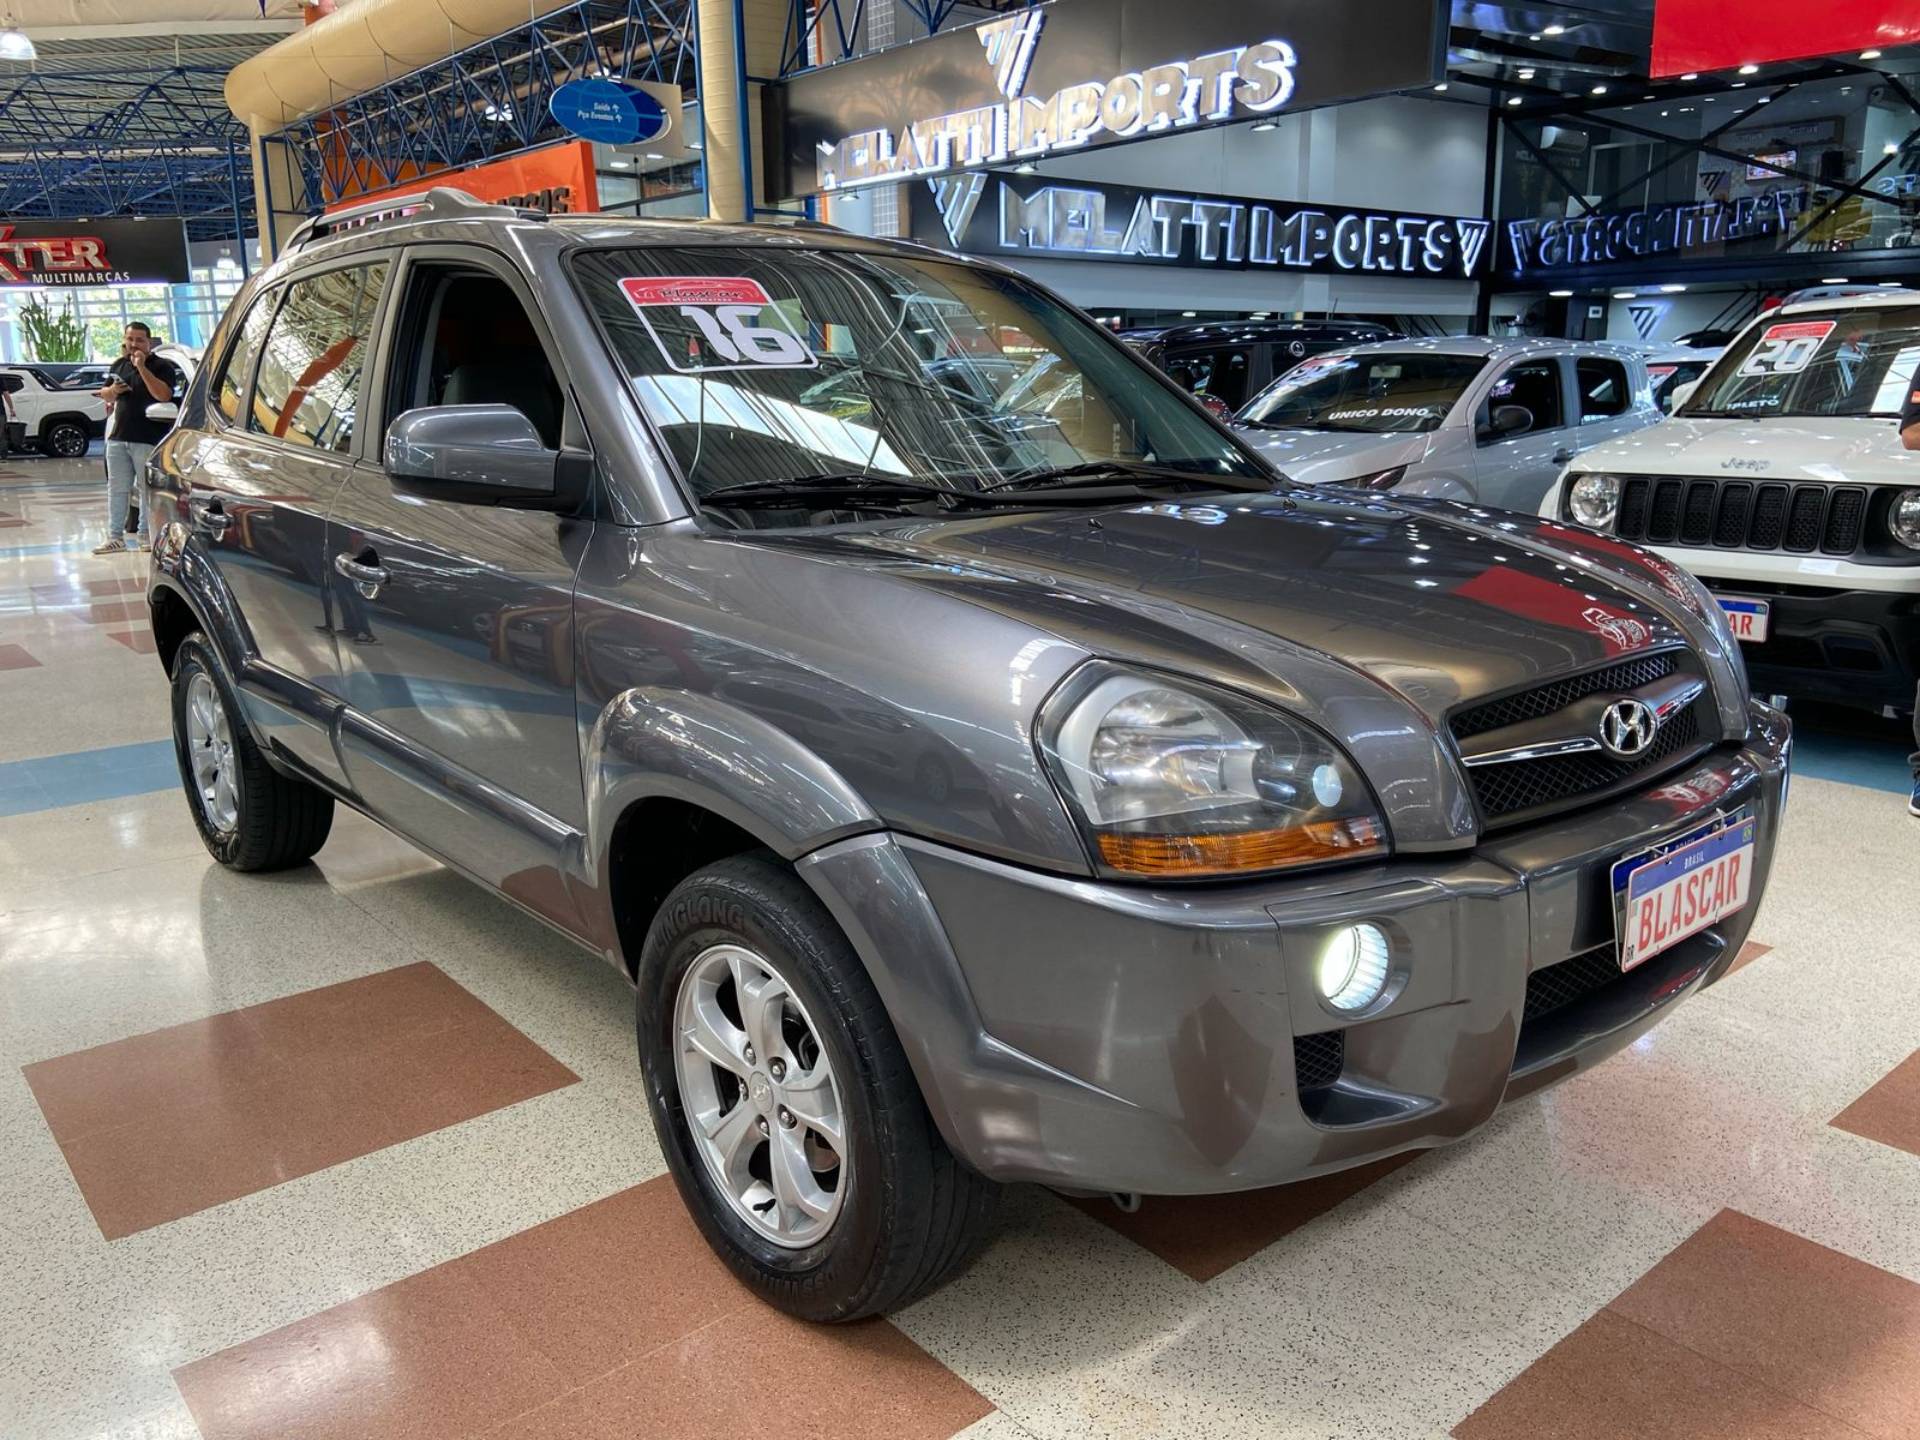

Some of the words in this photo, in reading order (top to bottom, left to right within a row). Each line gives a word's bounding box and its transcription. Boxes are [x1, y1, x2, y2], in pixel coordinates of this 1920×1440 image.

[1008, 40, 1297, 157] IMPORTS
[1249, 205, 1453, 272] IMPORTS
[33, 271, 130, 284] MULTIMARCAS
[681, 306, 805, 363] 16
[1743, 338, 1819, 373] 20
[1382, 407, 1429, 418] DONO
[1721, 457, 1770, 472] Jeep
[1684, 850, 1705, 870] BRASIL
[1638, 853, 1741, 951] BLASCAR
